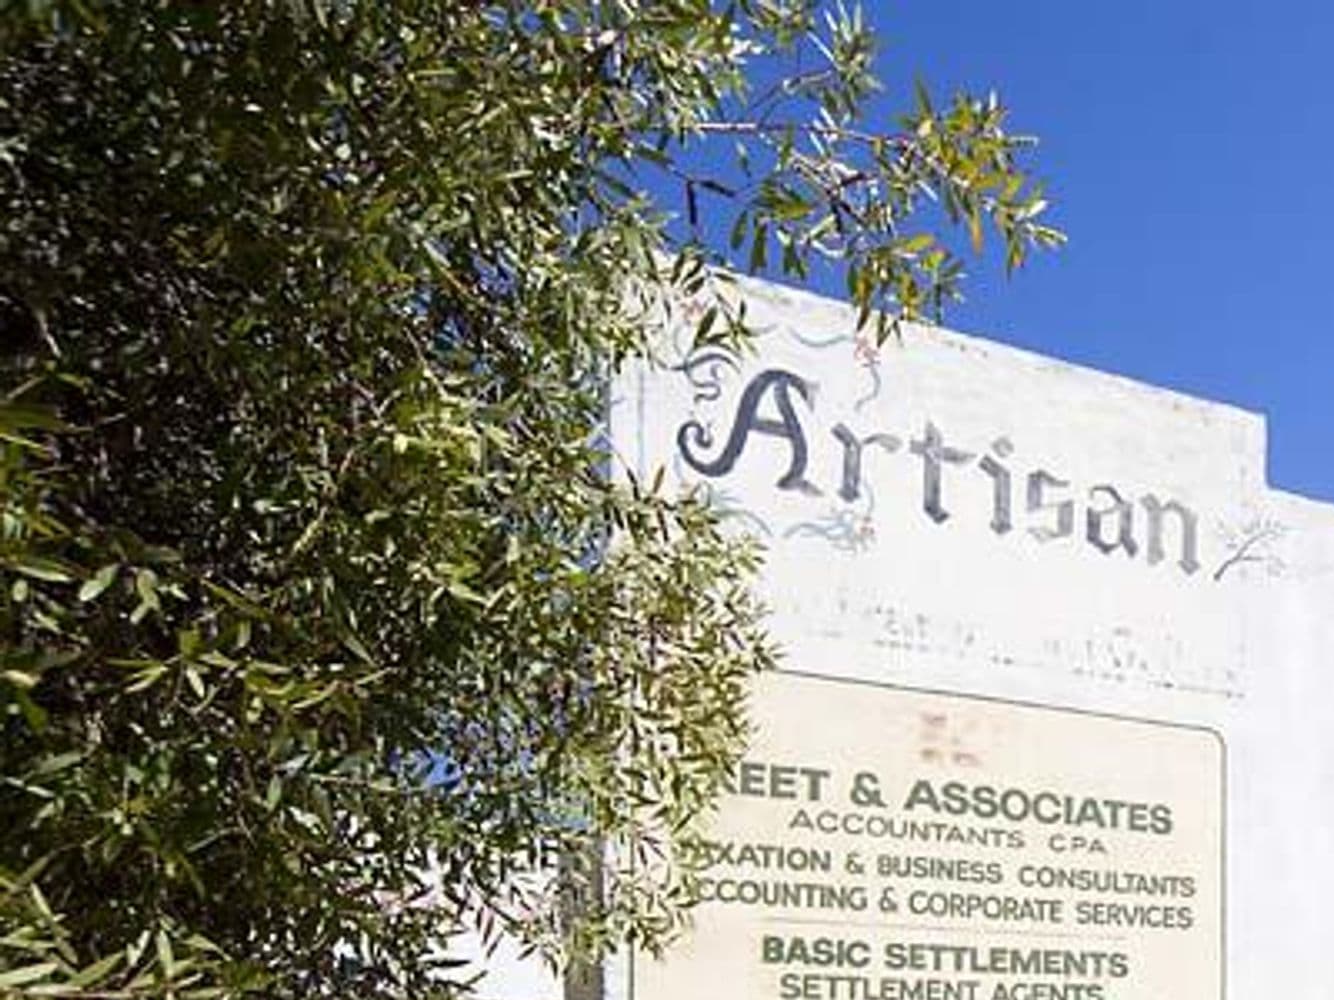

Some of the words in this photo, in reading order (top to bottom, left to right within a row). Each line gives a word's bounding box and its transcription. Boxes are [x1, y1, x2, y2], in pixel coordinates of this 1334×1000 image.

[676, 369, 1200, 577] Artisan
[706, 762, 830, 801] EET
[849, 772, 887, 808] &
[904, 780, 1173, 834] ASSOCIATES
[788, 809, 1026, 850] ACCOUNTANTS
[1048, 834, 1109, 855] CPA
[845, 852, 867, 875] &
[876, 854, 1003, 884] BUSINESS
[1018, 866, 1197, 899] CONSULTANTS
[681, 878, 869, 911] CCOUNTING
[878, 889, 900, 913] &
[909, 890, 1064, 924] CORPORATE
[1075, 904, 1194, 930] SERVICES
[762, 935, 871, 968] BASIC
[884, 943, 1130, 978] SETTLEMENTS
